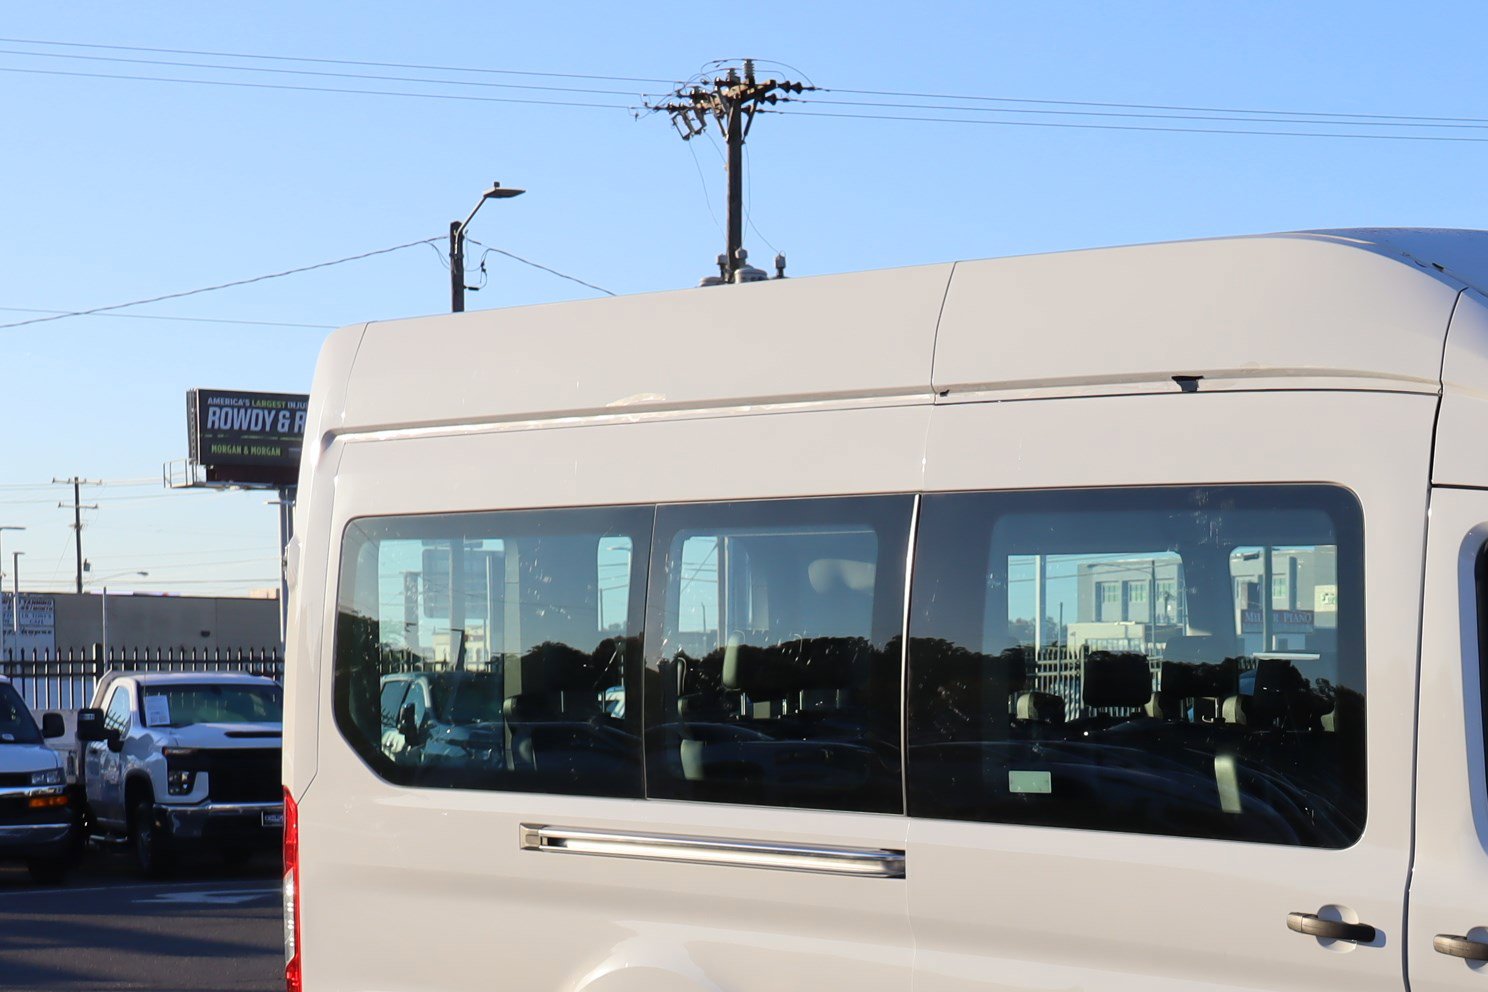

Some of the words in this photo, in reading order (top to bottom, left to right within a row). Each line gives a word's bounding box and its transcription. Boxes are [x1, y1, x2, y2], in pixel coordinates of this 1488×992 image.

[207, 397, 250, 406] AMERICA'S
[251, 399, 287, 408] LARGEST
[207, 406, 276, 432] ROWDY
[277, 410, 291, 433] &
[211, 444, 241, 455] MORGAN
[250, 446, 281, 456] MORGAN
